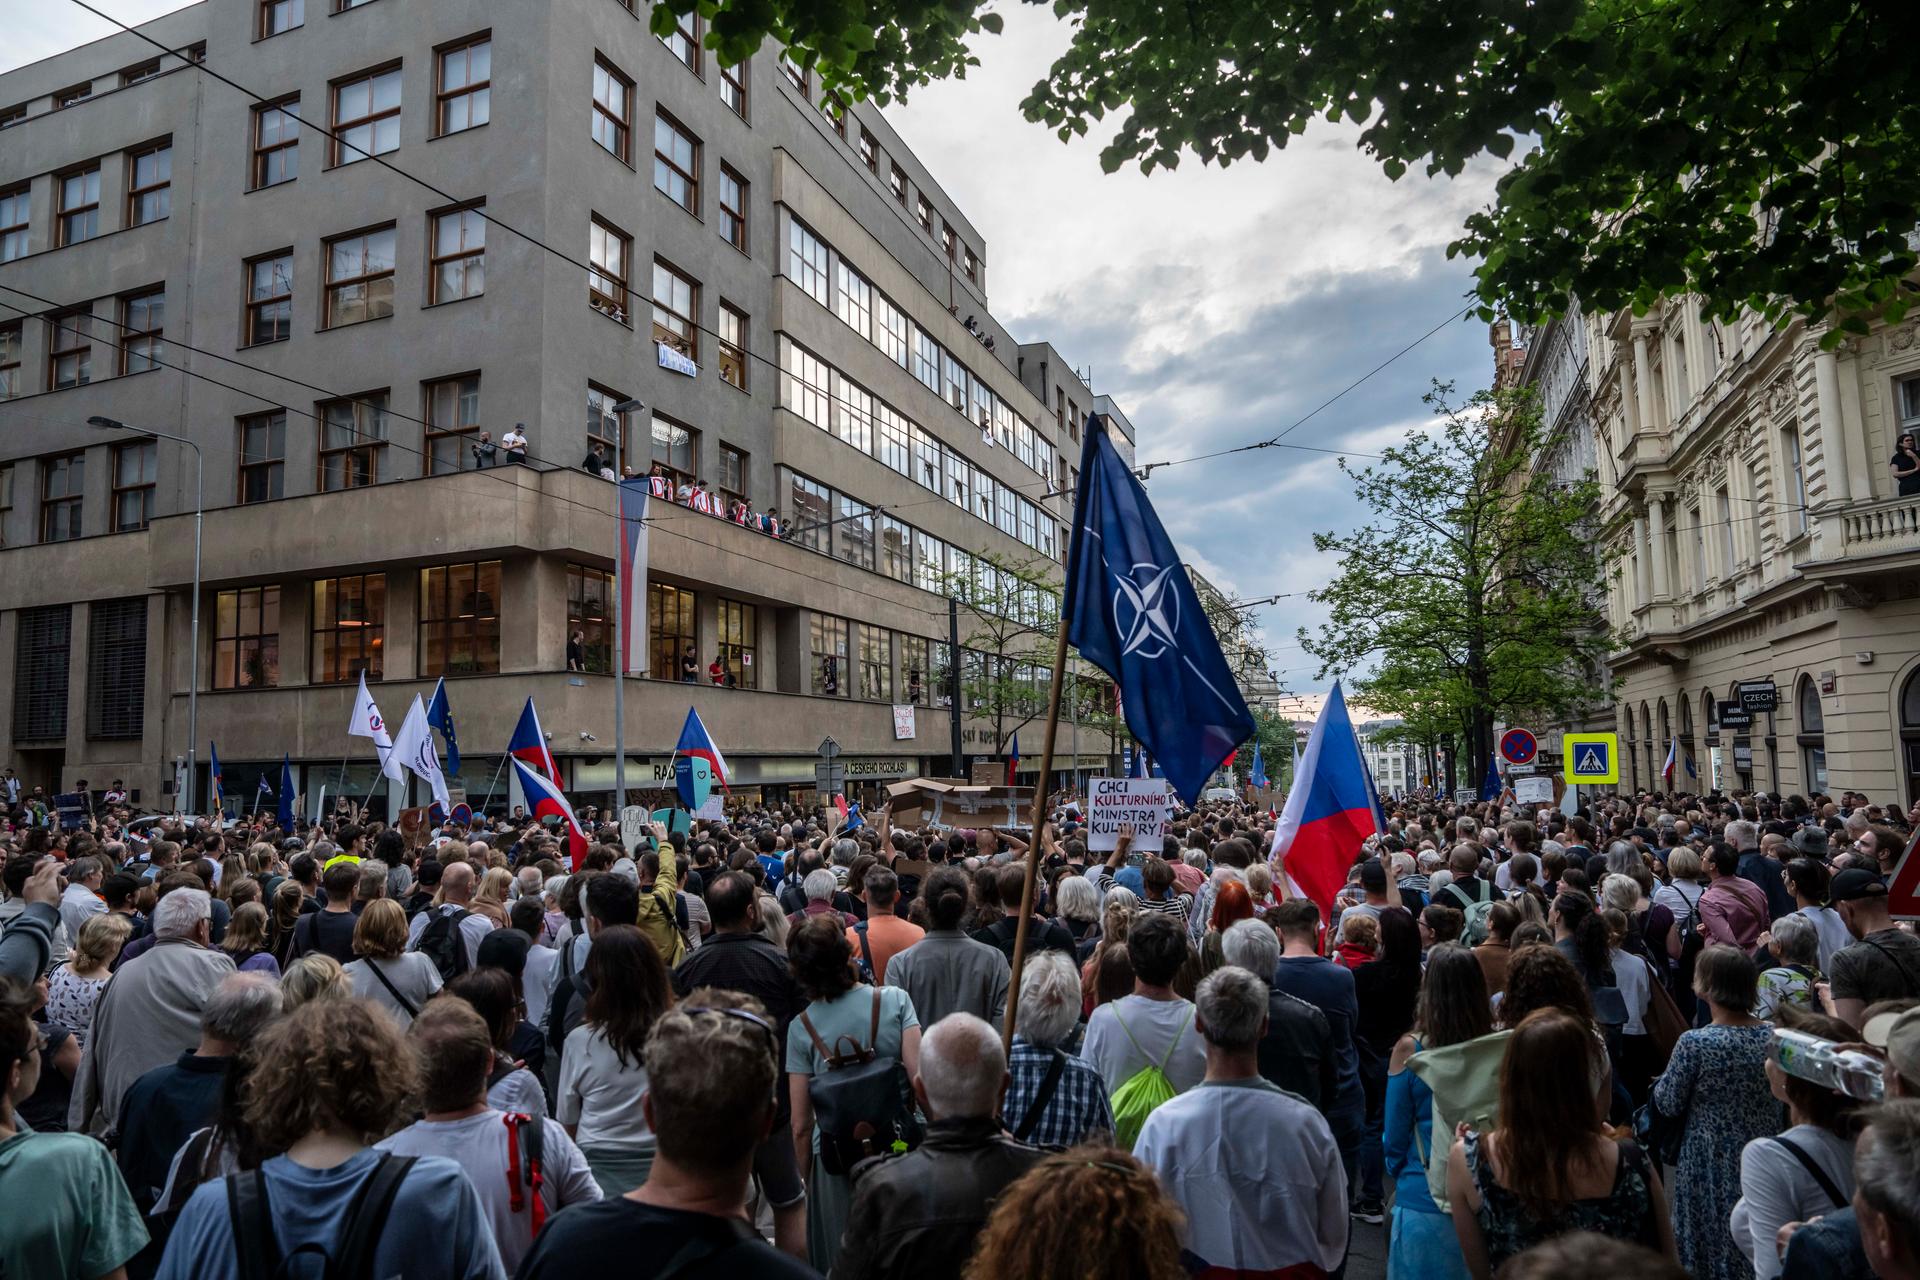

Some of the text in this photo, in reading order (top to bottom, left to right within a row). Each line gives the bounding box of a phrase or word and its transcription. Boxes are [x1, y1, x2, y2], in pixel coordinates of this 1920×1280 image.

[1743, 693, 1773, 702] CZECH
[850, 760, 878, 775] ČESKÉHO
[1098, 781, 1128, 794] CHCI
[1095, 791, 1166, 807] KULTURNÍHO
[1093, 809, 1155, 822] MINISTRA
